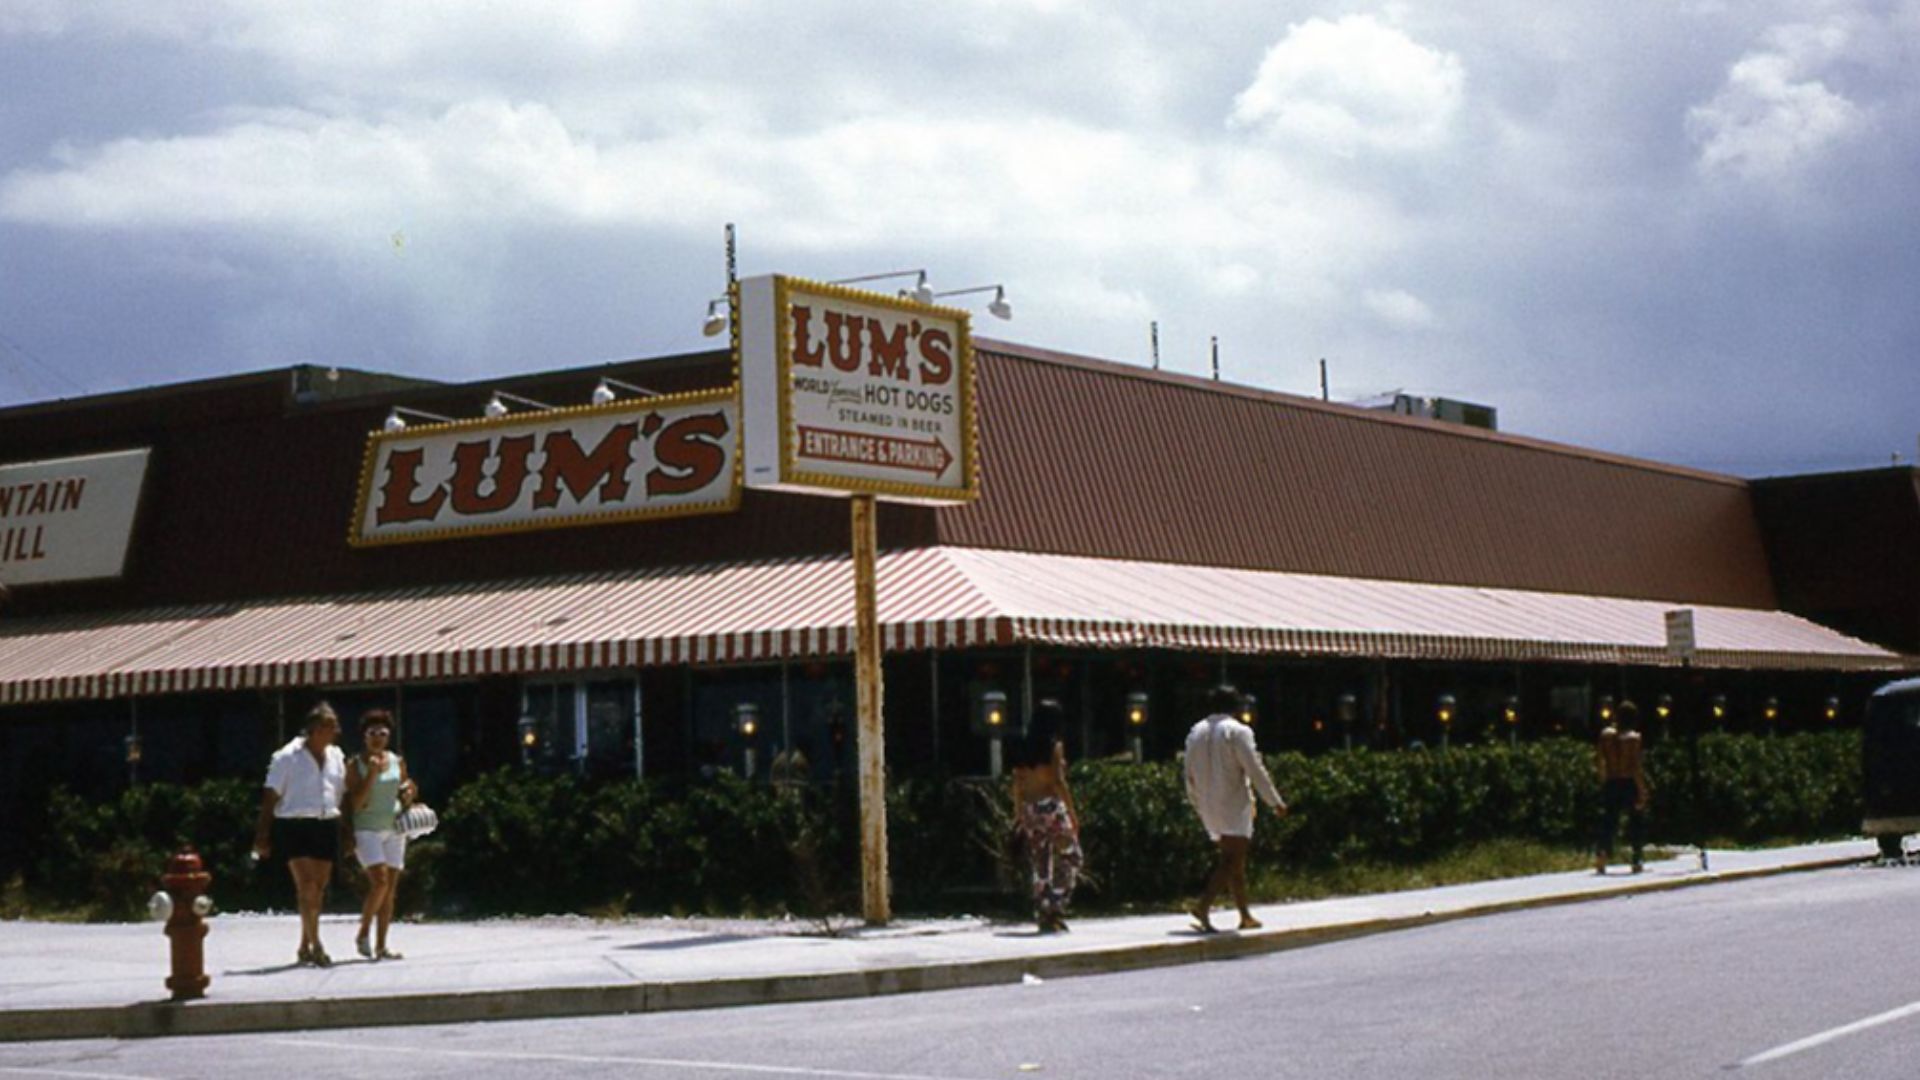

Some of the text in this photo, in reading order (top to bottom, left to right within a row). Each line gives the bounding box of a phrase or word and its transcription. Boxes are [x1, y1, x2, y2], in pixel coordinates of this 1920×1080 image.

[791, 304, 952, 386] LUM'S
[794, 377, 829, 394] WORLD
[865, 384, 900, 406] HOT
[906, 389, 954, 415] DOGS
[838, 407, 943, 433] STEAMED IN BEER
[376, 409, 729, 527] LUM'S
[805, 430, 946, 470] ENTRANCE & PARKING
[0, 525, 46, 562] ILL
